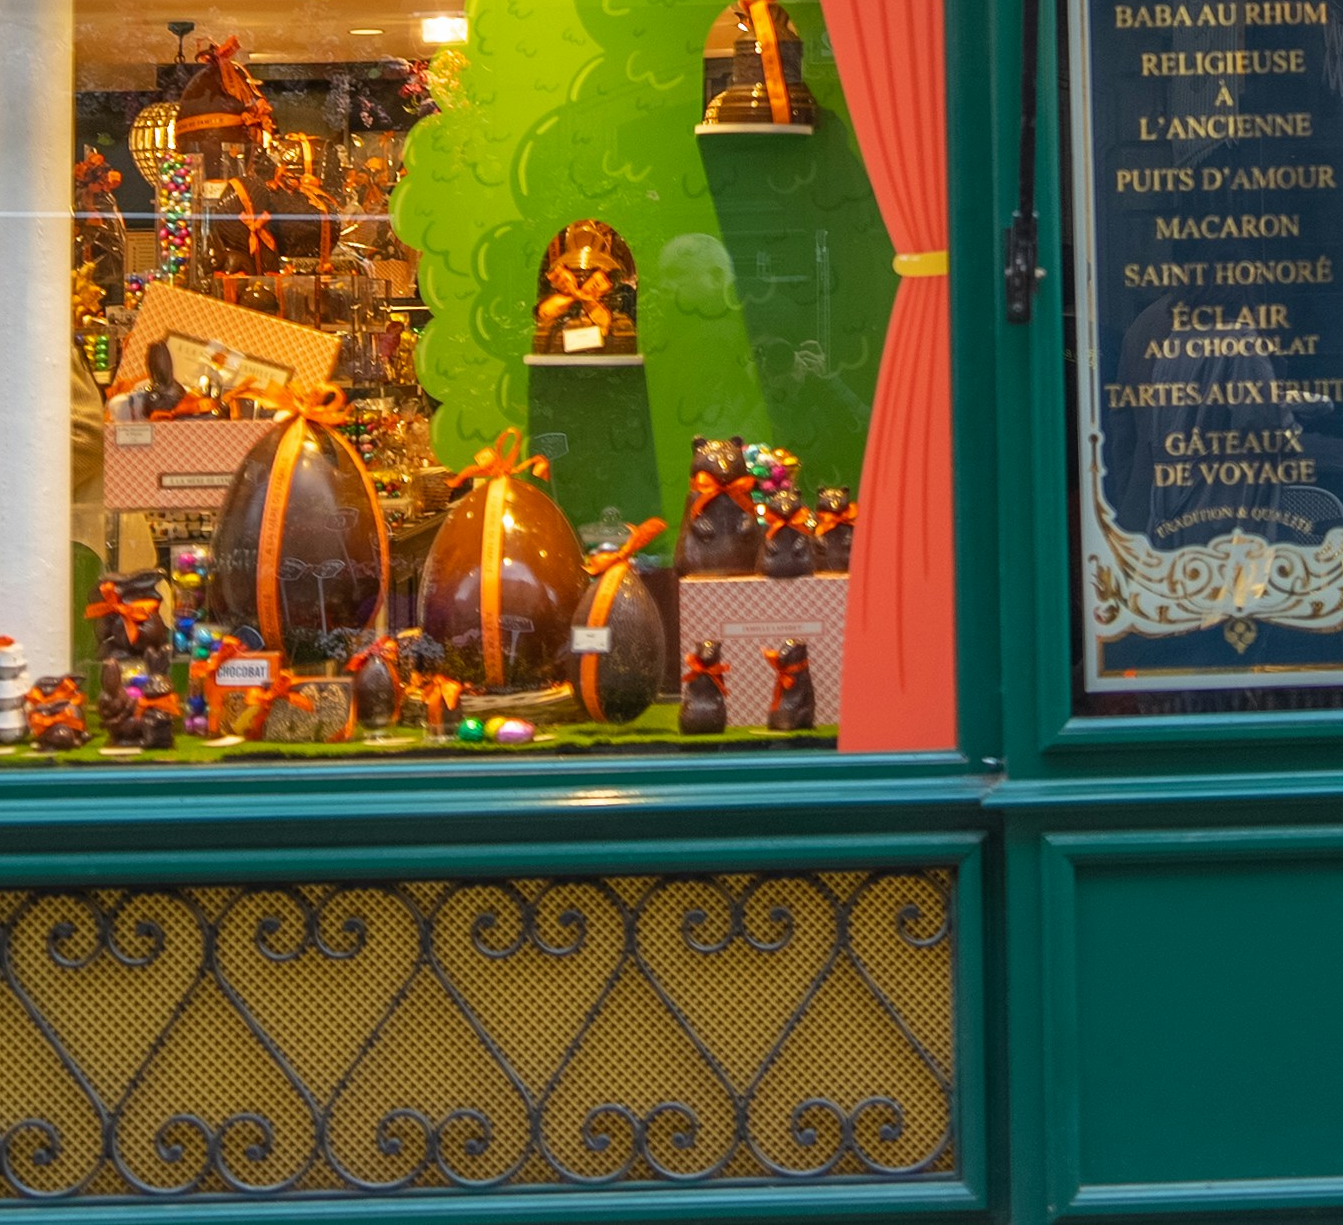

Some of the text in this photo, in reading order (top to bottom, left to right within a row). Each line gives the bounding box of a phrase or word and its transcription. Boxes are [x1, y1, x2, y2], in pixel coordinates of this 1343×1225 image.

[1114, 1, 1329, 28] BABA AU RHUM
[1140, 49, 1307, 77] RELIGIEUSE
[1138, 112, 1313, 141] L'ANCIENNE
[1115, 164, 1337, 193] PUITS D'AMOUR
[1154, 214, 1301, 240] MACARON
[1123, 255, 1333, 288] SAINT HONORÉ
[1171, 300, 1291, 332] ÉCLAIR
[1144, 334, 1320, 359] AU CHOCOLAT
[1104, 383, 1203, 408] TARTES
[1206, 380, 1264, 406] AUX
[1164, 428, 1304, 457] GÂTEAUX
[1154, 458, 1317, 488] DE VOYAGE
[1156, 505, 1234, 539] TRADITION
